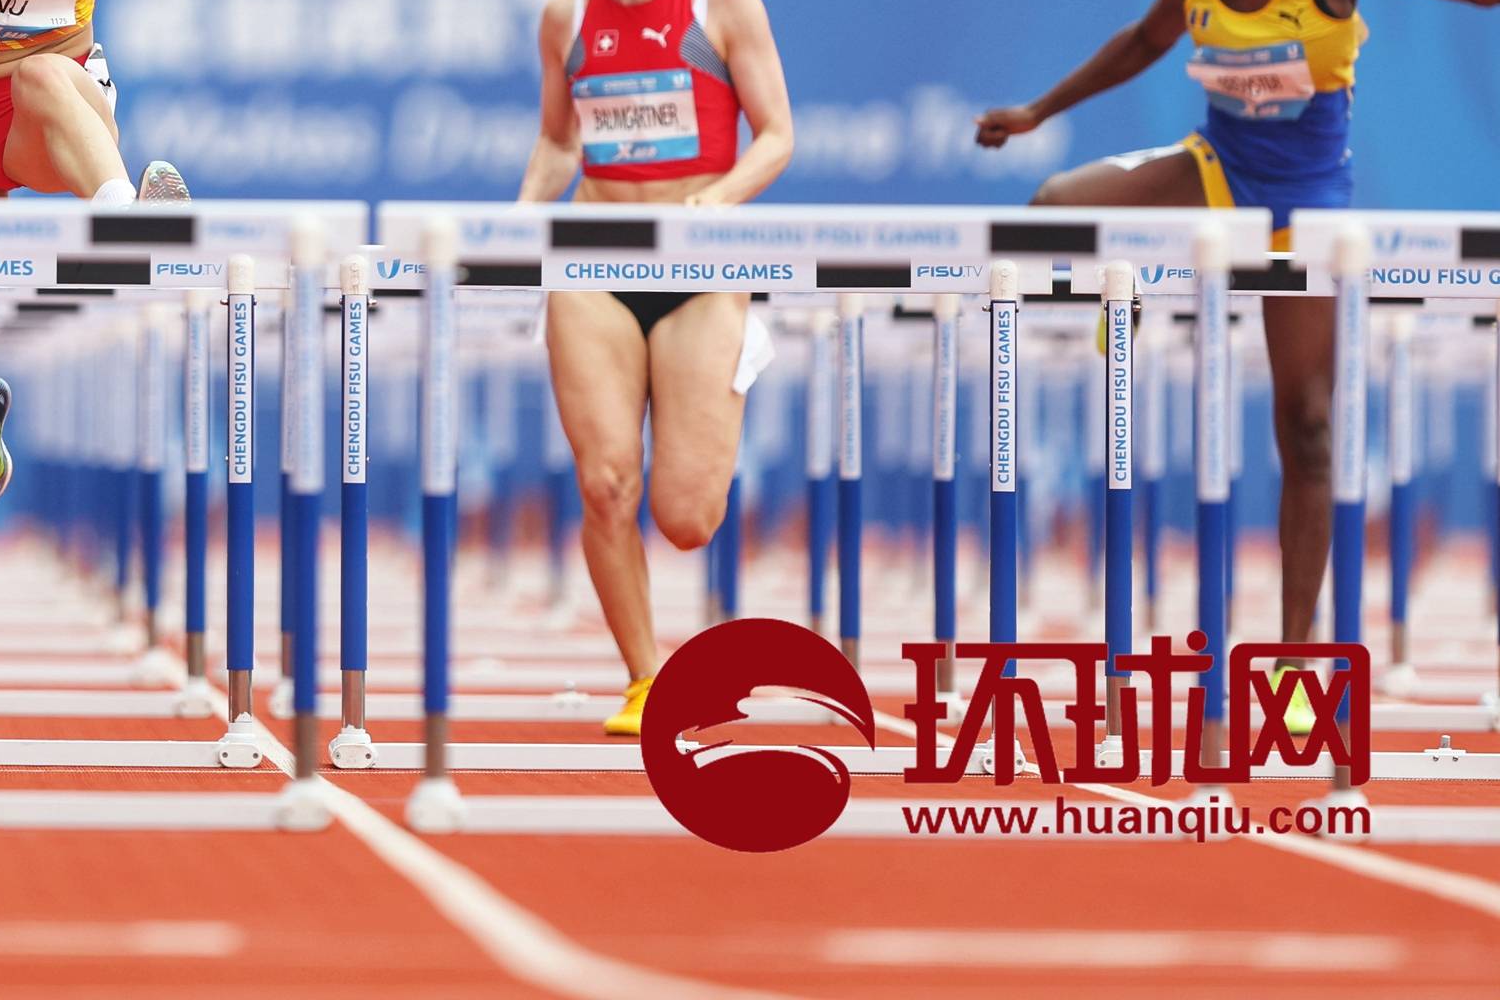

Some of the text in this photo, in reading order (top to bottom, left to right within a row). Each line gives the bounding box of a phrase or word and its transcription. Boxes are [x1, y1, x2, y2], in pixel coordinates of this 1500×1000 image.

[592, 103, 679, 131] BAUMGARTNER
[156, 263, 223, 276] FISU.TV
[403, 263, 427, 274] FIS
[564, 262, 794, 281] CHENGDU FISU GAMES
[916, 265, 984, 278] FISU.TV
[1437, 268, 1482, 285] FISU
[235, 303, 247, 476] CHENGDU FISU GAMES
[348, 302, 361, 476] CHENGDU FISU GAMES
[998, 311, 1011, 484] CHENGDU FISU GAMES
[1114, 308, 1127, 482] CHENGDU FISU GAMES
